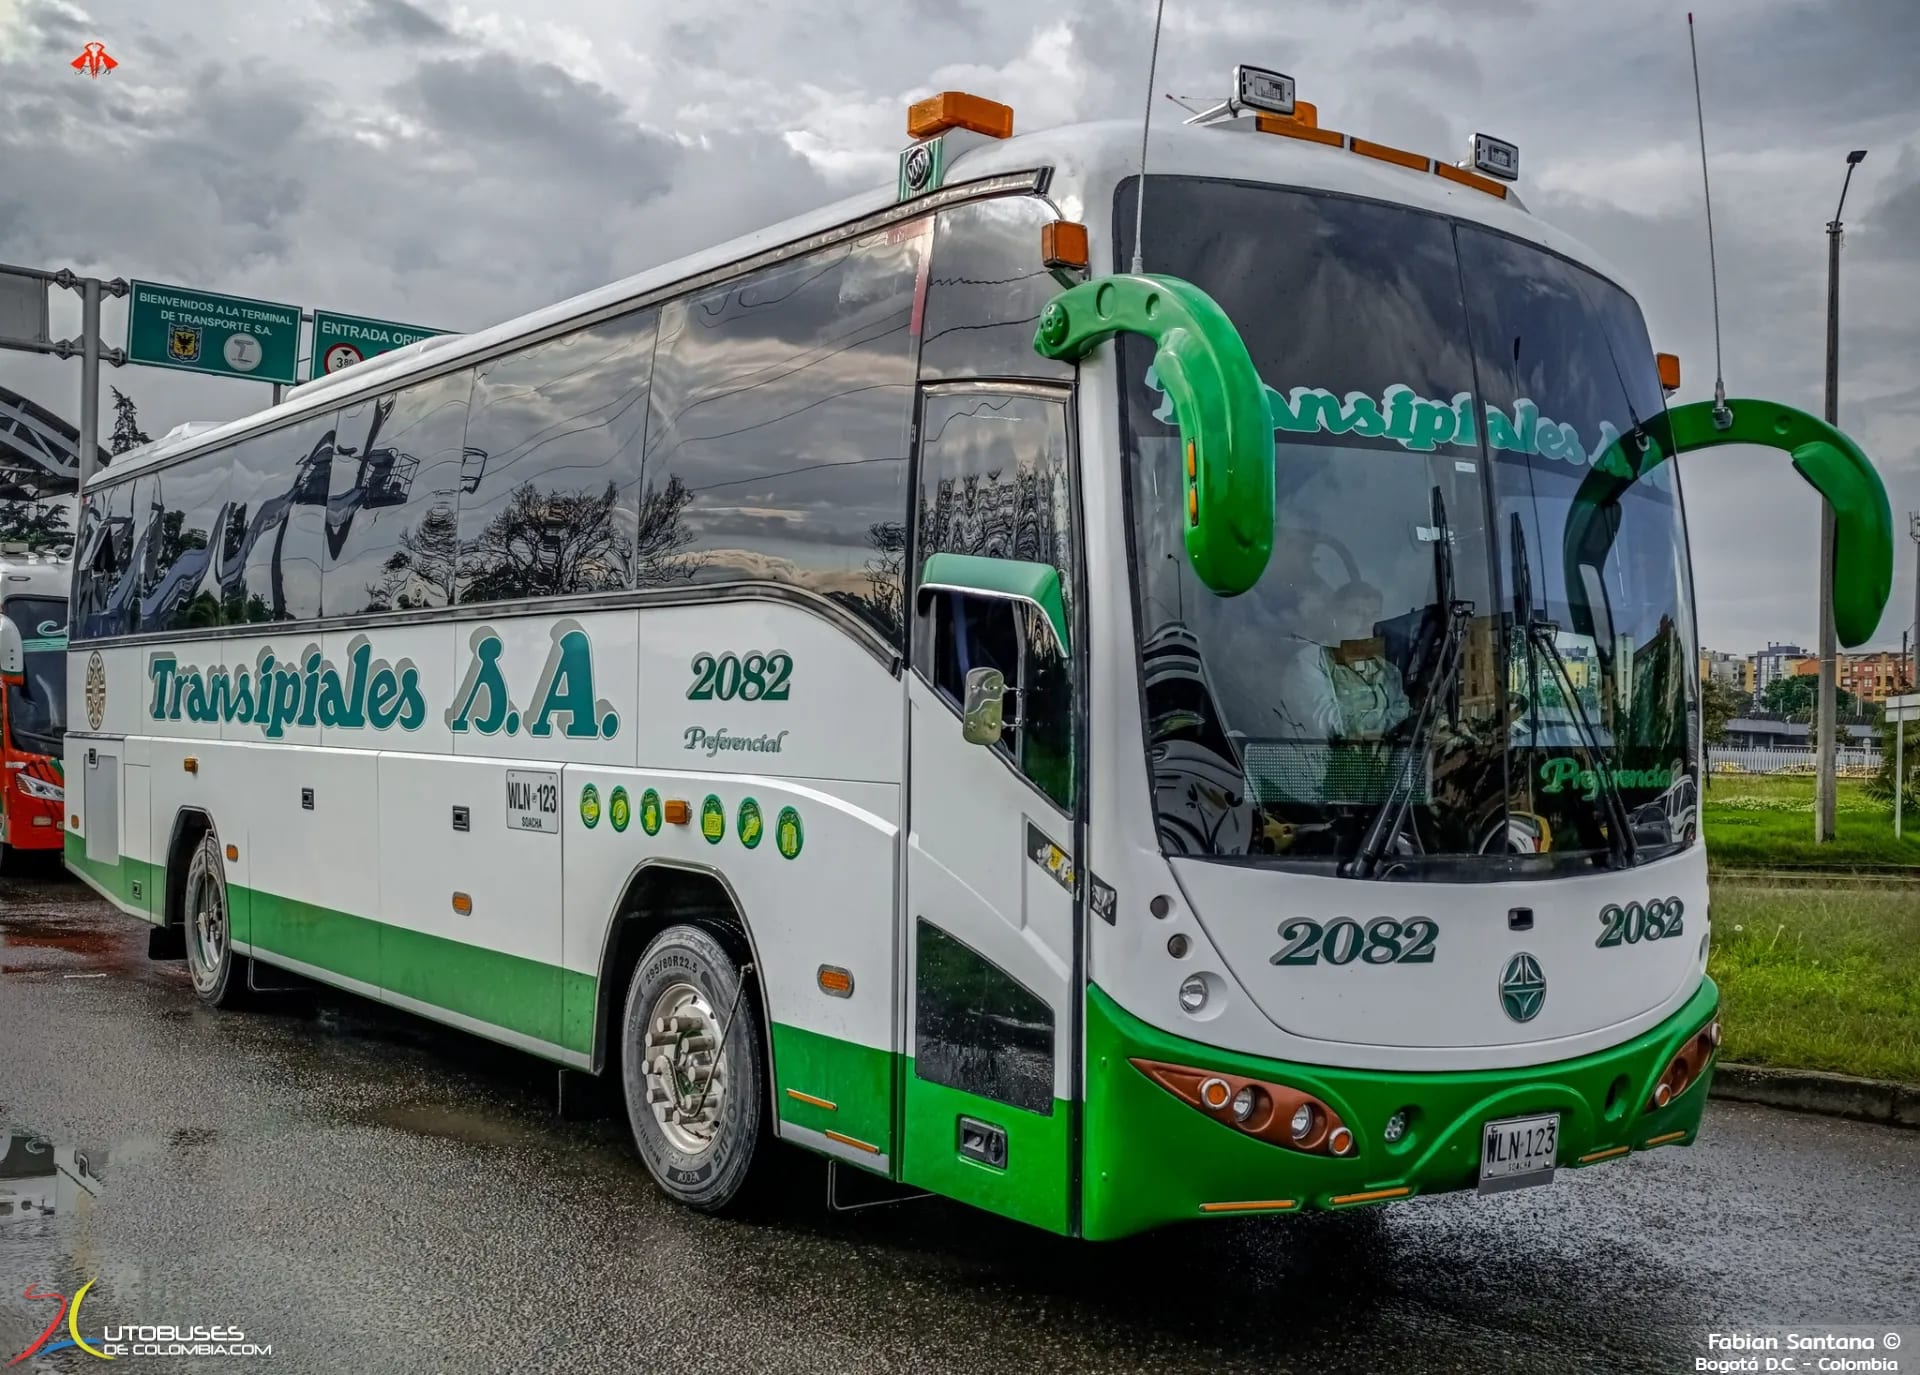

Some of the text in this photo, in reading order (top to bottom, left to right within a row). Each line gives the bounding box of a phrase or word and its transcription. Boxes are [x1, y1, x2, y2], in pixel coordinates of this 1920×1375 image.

[139, 292, 214, 312] BIENVENIDOS
[225, 307, 239, 317] LA
[241, 309, 293, 325] TERMINAL
[160, 310, 272, 336] DE TRANSPORTE S.A.
[322, 321, 389, 343] ENTRADA
[1145, 366, 1586, 466] ansipiales
[149, 617, 621, 740] Transipiales S.A.
[685, 648, 794, 701] 2082
[684, 726, 789, 758] Preferencial
[1270, 915, 1440, 966] 2082
[1595, 896, 1684, 948] 2082
